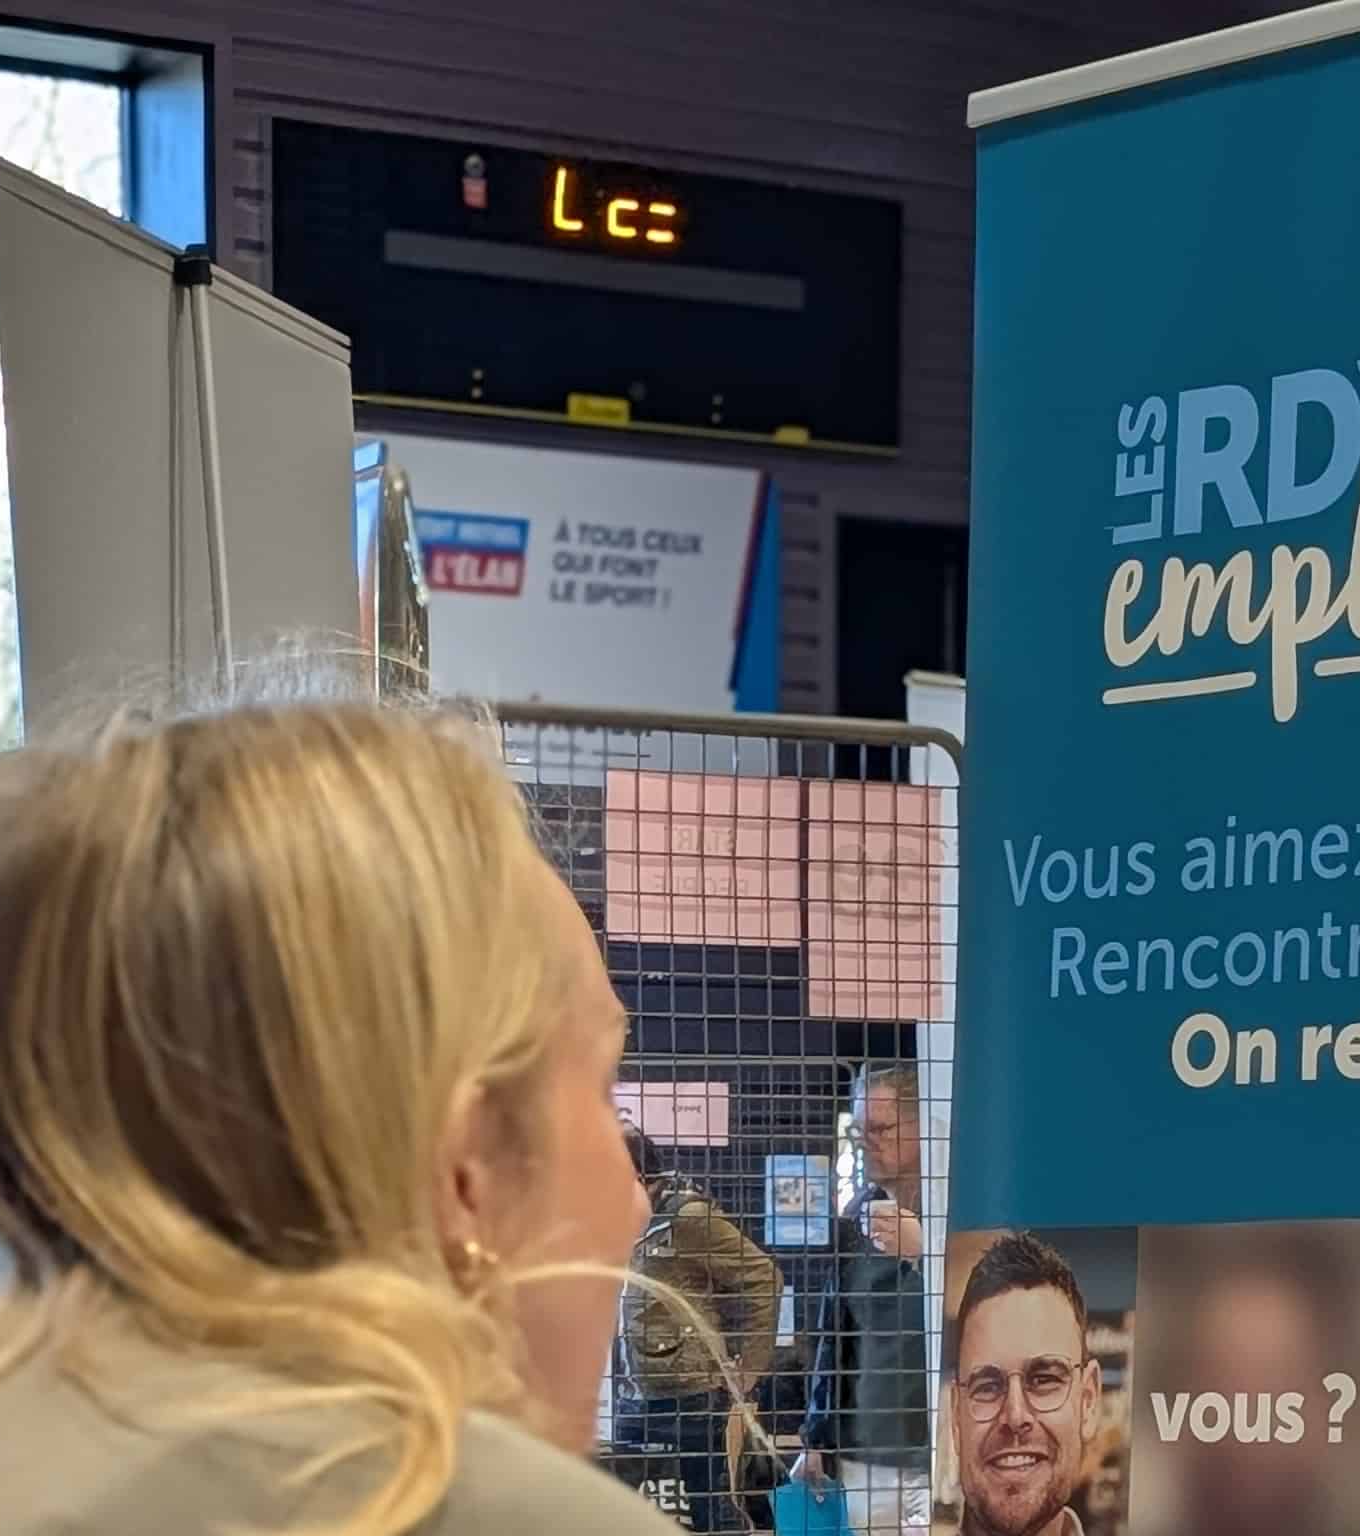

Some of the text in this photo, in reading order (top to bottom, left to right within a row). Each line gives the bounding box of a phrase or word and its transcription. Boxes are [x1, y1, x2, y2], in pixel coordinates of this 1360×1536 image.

[1112, 395, 1167, 544] LES
[1003, 835, 1157, 907] Vous
[1172, 1013, 1277, 1088] On
[1150, 1372, 1358, 1444] vous ?
